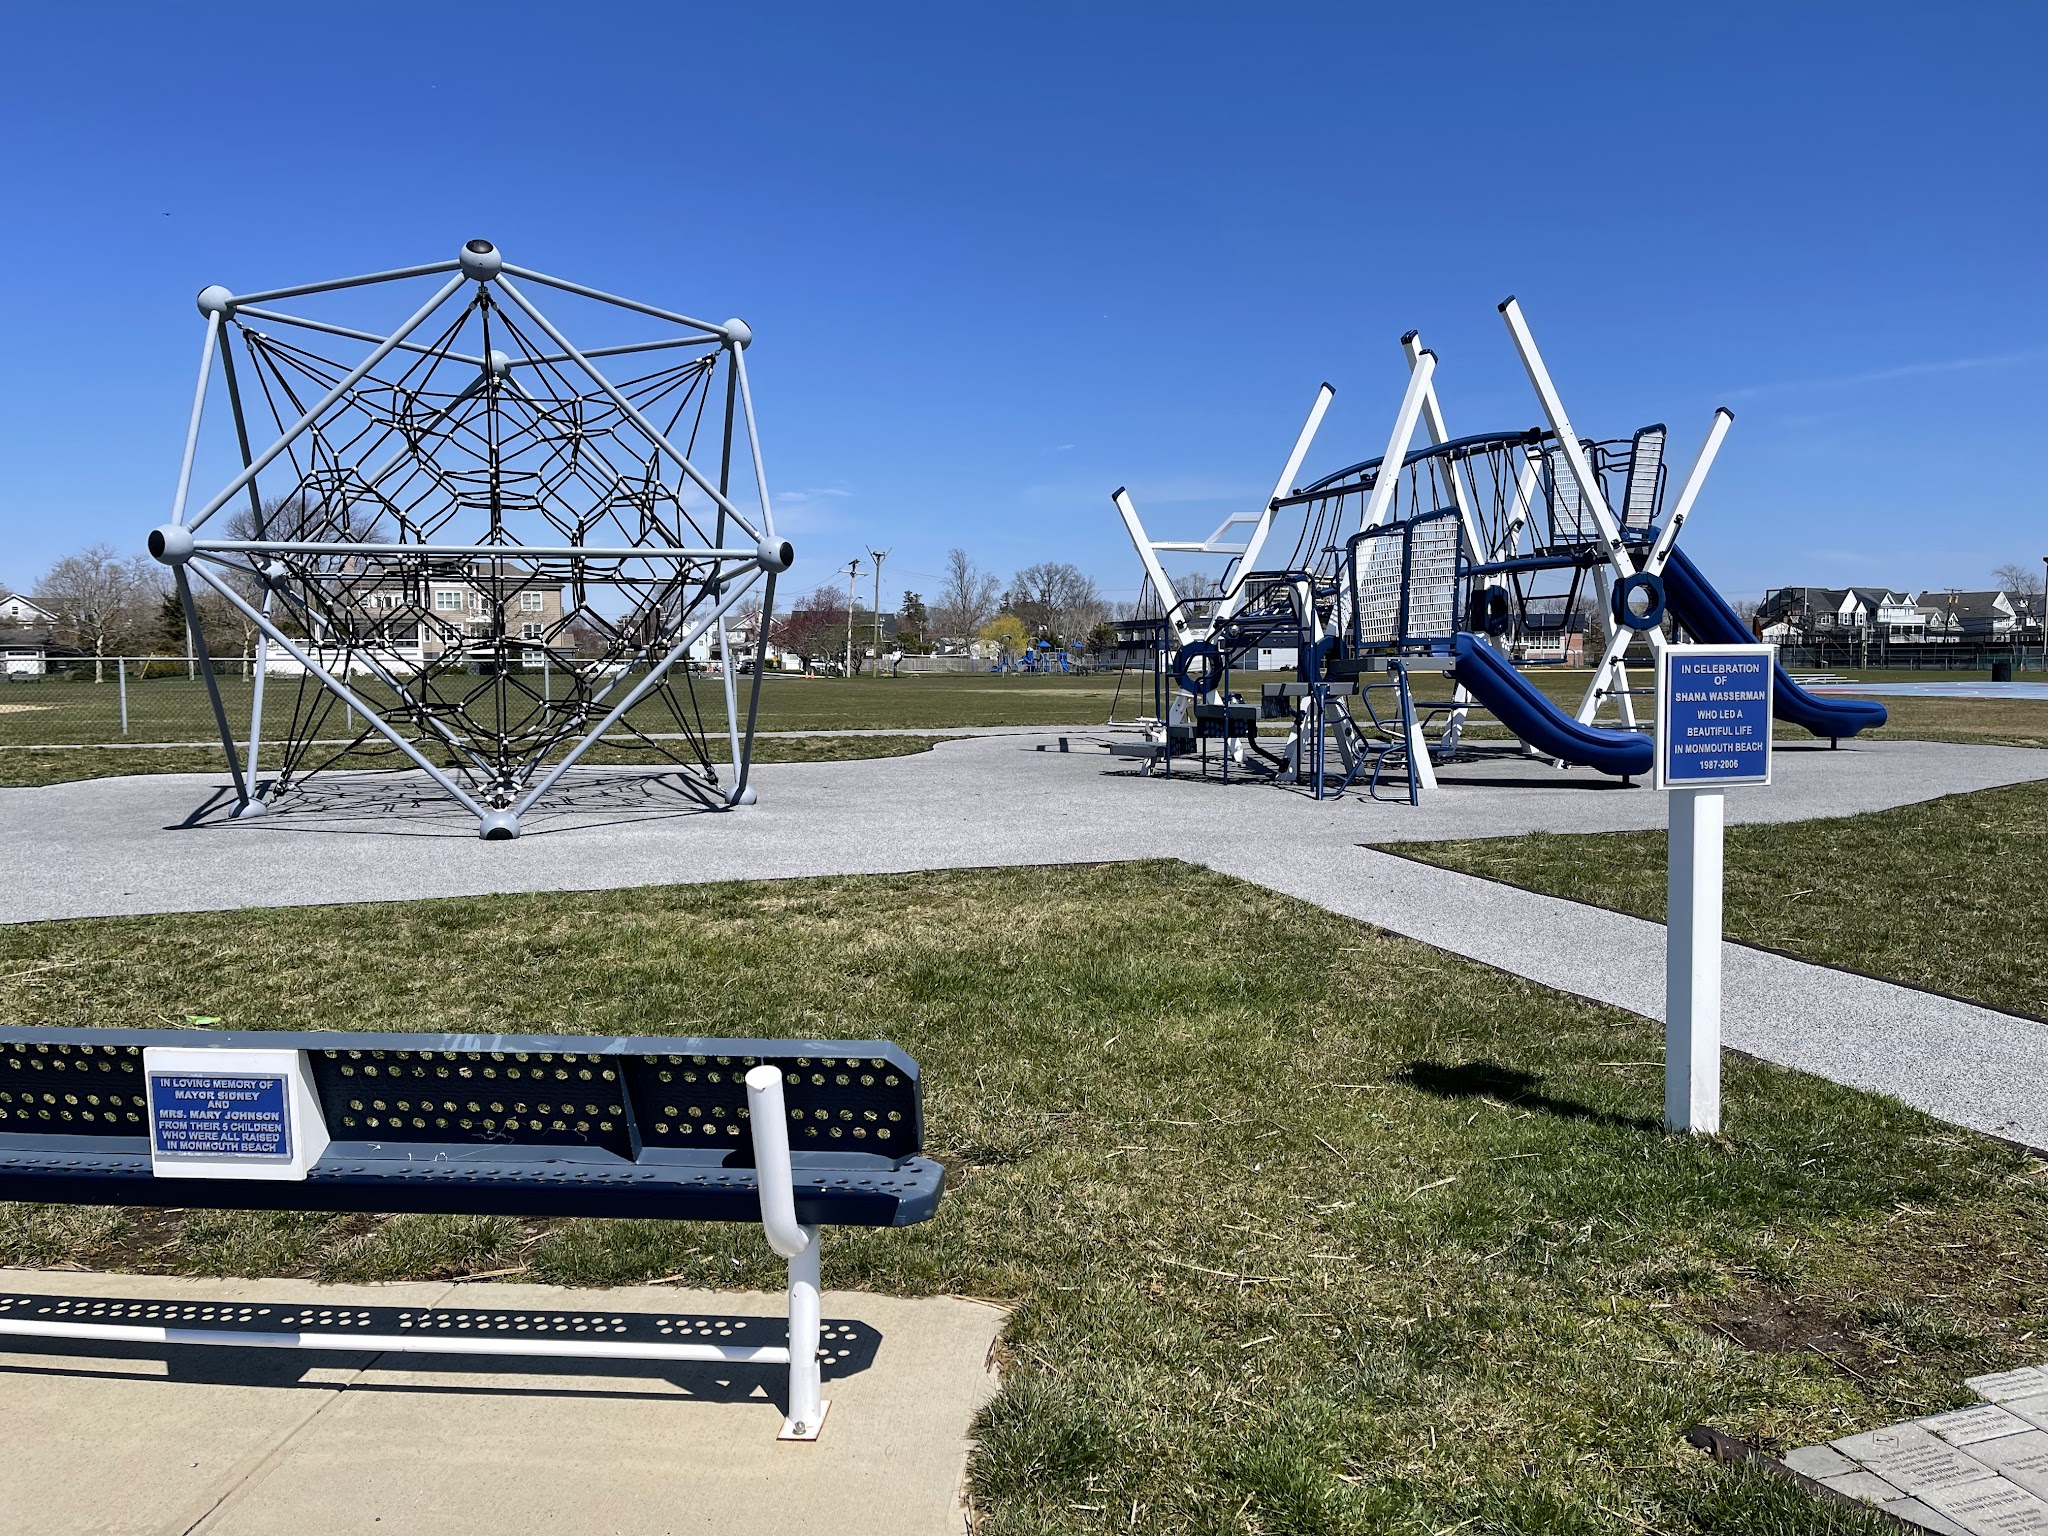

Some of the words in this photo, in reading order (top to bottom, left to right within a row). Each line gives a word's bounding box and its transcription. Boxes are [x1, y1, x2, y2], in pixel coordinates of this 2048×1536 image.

[1682, 665, 1691, 674] IN
[1694, 664, 1759, 673] CELEBRATION
[1714, 676, 1727, 685] OF
[1676, 693, 1707, 701] SHANA
[1709, 691, 1765, 700] WASSERMAN
[1698, 711, 1717, 719] WHO
[1720, 710, 1735, 718] LED
[1737, 710, 1743, 718] A
[1688, 727, 1734, 736] BEAUTIFUL
[1735, 726, 1752, 735] LIFE
[1675, 745, 1683, 754] IN
[1686, 743, 1733, 753] MONMOUTH
[1736, 742, 1762, 752] BEACH
[1700, 760, 1738, 769] 1987-2006
[173, 1079, 210, 1088] LOVING
[214, 1080, 257, 1089] MEMORY
[259, 1081, 273, 1089] OF
[175, 1090, 214, 1099] MAYOR
[218, 1091, 260, 1100] SIDNEY
[160, 1110, 186, 1119] MRS.
[190, 1110, 222, 1119] MARY
[225, 1112, 279, 1121] JOHNSON
[190, 1122, 220, 1130] THEIR
[223, 1123, 228, 1131] 5
[231, 1123, 281, 1132] CHILDREN
[162, 1131, 186, 1139] WHO
[189, 1132, 218, 1140] WERE
[221, 1132, 239, 1141] ALL
[242, 1133, 279, 1142] RAISED
[180, 1142, 238, 1151] MONMOUTH
[242, 1143, 276, 1152] BEACH
